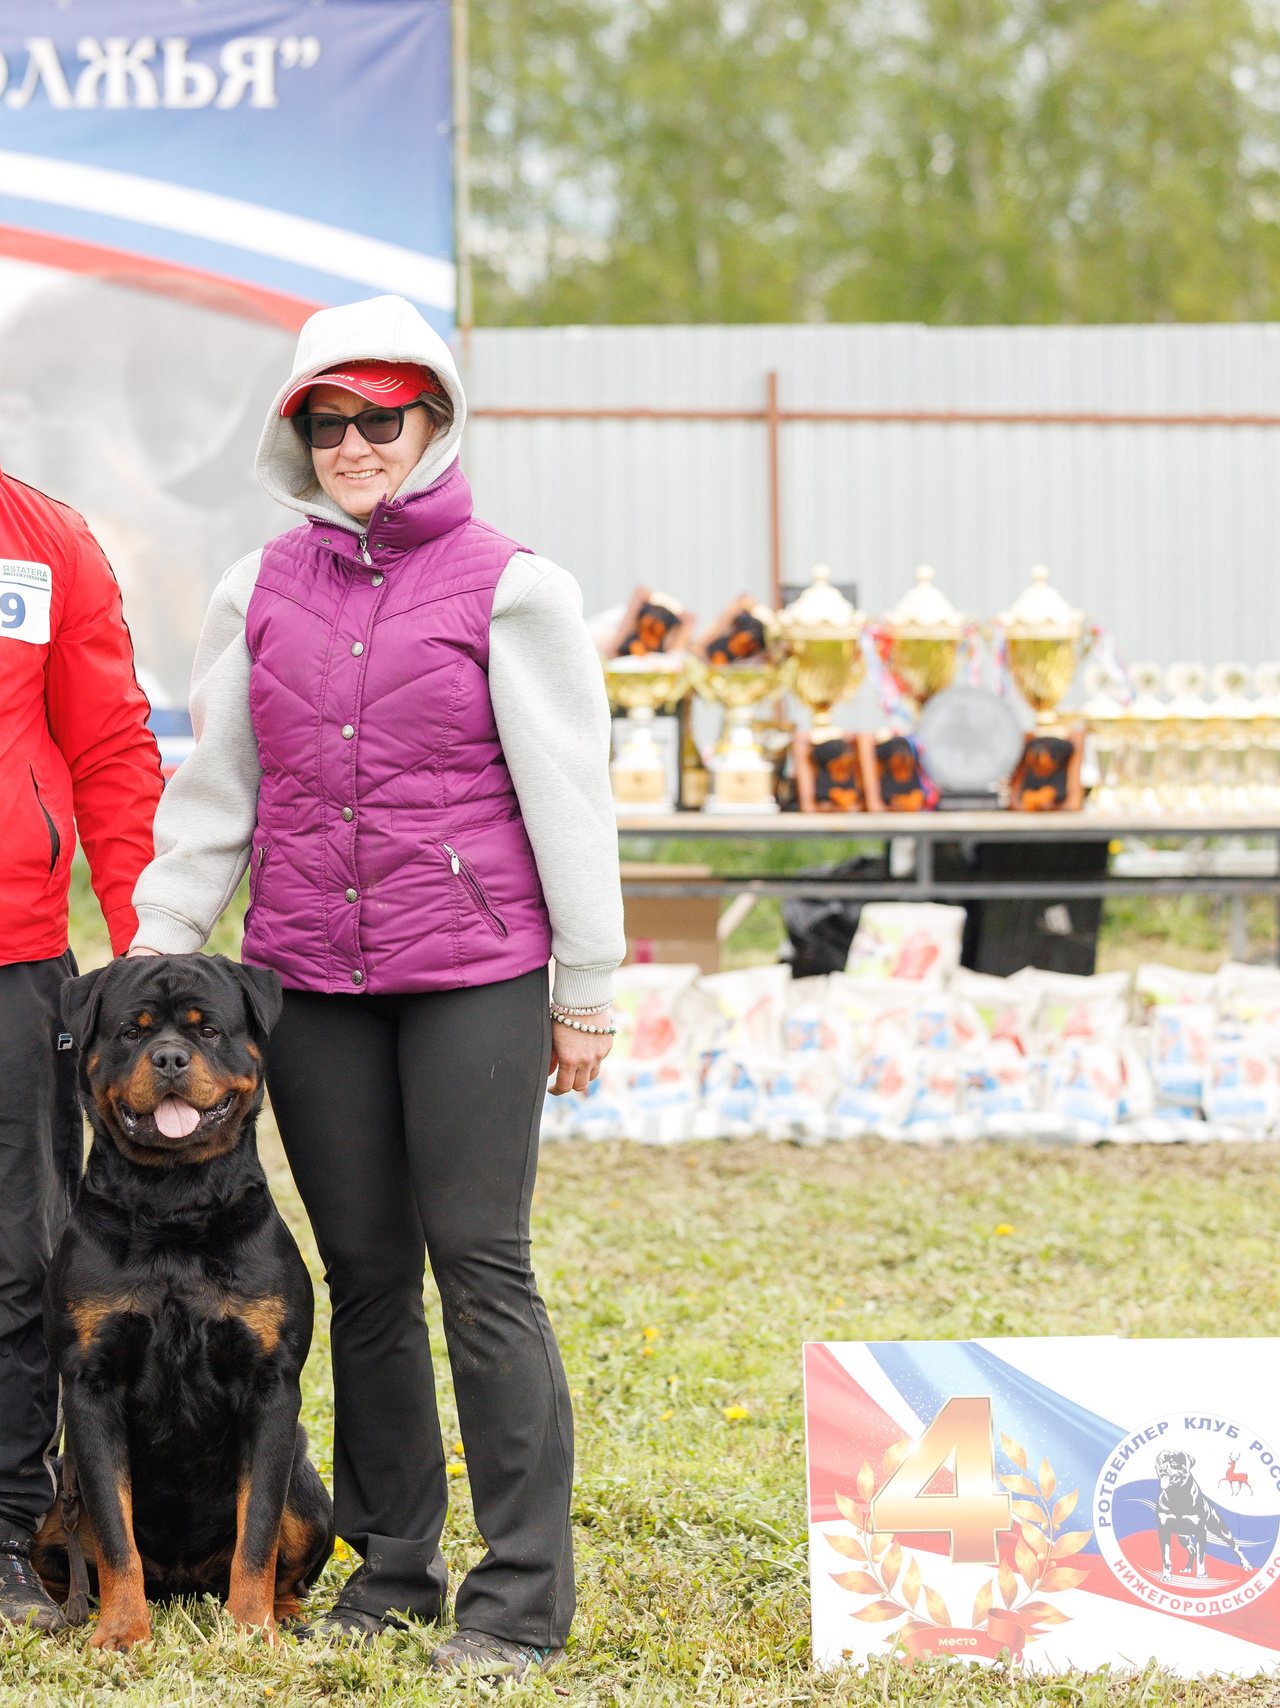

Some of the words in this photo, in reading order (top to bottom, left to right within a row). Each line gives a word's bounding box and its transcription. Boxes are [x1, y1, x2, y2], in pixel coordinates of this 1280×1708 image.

[9, 565, 48, 579] STATERA
[871, 1394, 1013, 1566] 4
[1098, 1421, 1169, 1528] РОТВЕЙЛЕР
[1184, 1417, 1240, 1439] КЛУБ
[1113, 1559, 1266, 1615] НИЖЕГОРОДСКОЕ
[937, 1635, 978, 1647] место
